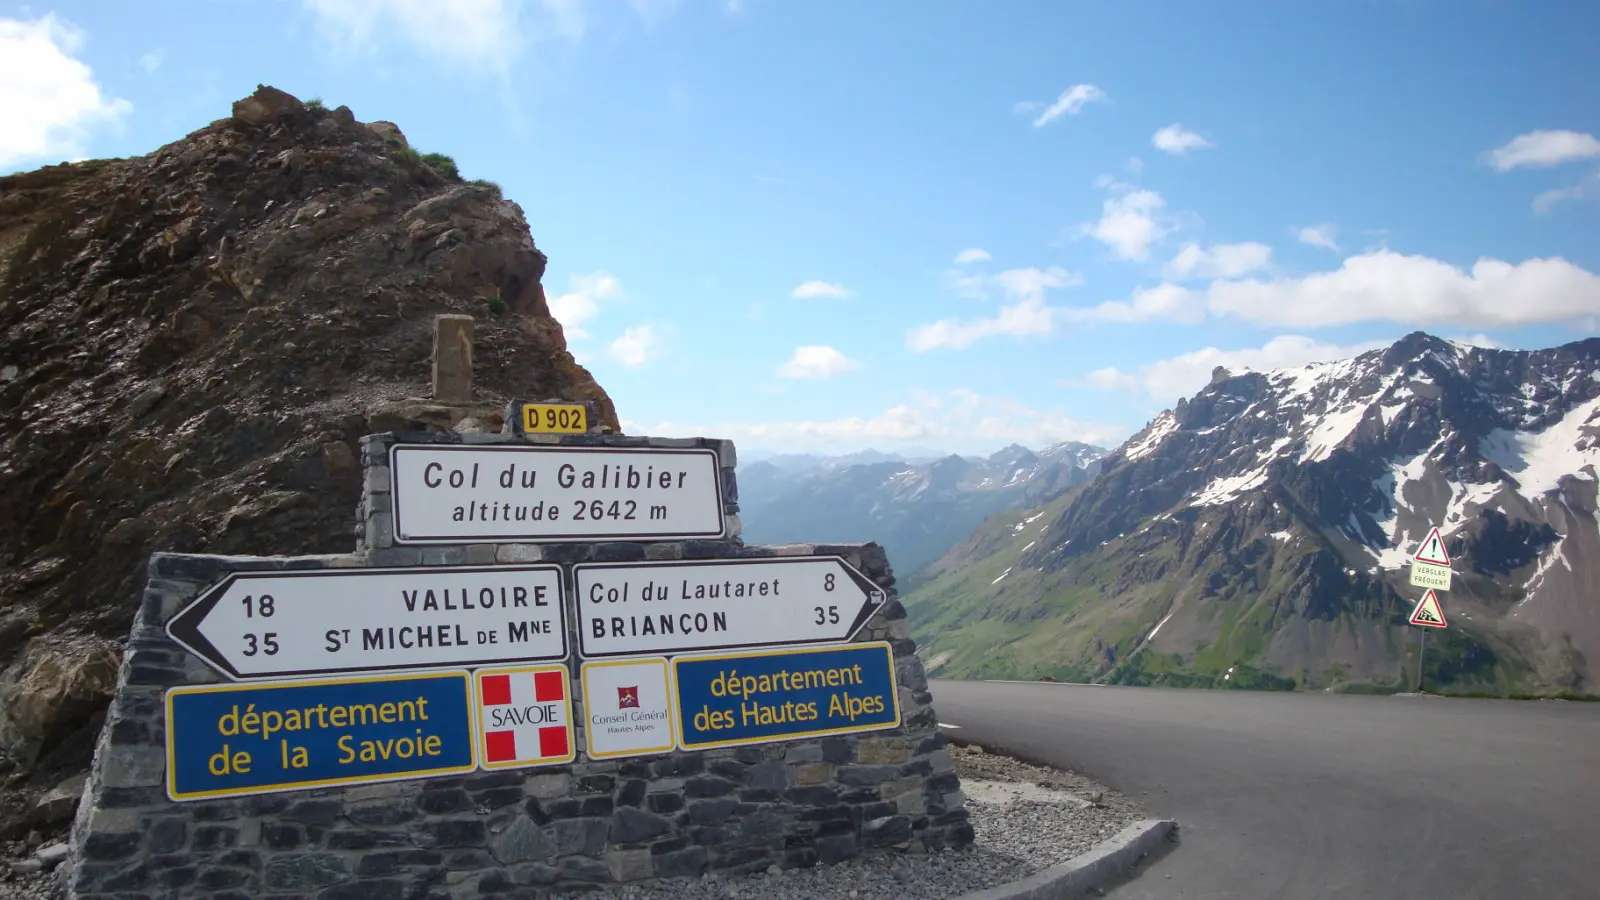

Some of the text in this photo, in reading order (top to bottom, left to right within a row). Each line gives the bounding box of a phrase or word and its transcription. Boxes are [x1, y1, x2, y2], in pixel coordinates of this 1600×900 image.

[528, 408, 582, 429] D 902
[423, 462, 688, 490] Col du Galibier
[452, 500, 667, 522] altitude 2642 m
[1417, 566, 1446, 577] VERGLAS
[241, 585, 549, 619] 18 VALLOIRE
[590, 573, 836, 604] Col du Lautaret 8
[592, 606, 840, 639] BRIANÇON 35
[241, 632, 280, 657] 35
[362, 624, 469, 651] MICHEL
[477, 630, 498, 645] DE
[710, 663, 863, 700] département
[218, 696, 429, 740] département
[492, 704, 558, 728] SAVOIE
[592, 709, 668, 725] Conseil Général
[694, 692, 885, 731] des Hautes Alpes
[208, 728, 442, 776] de la Savoie
